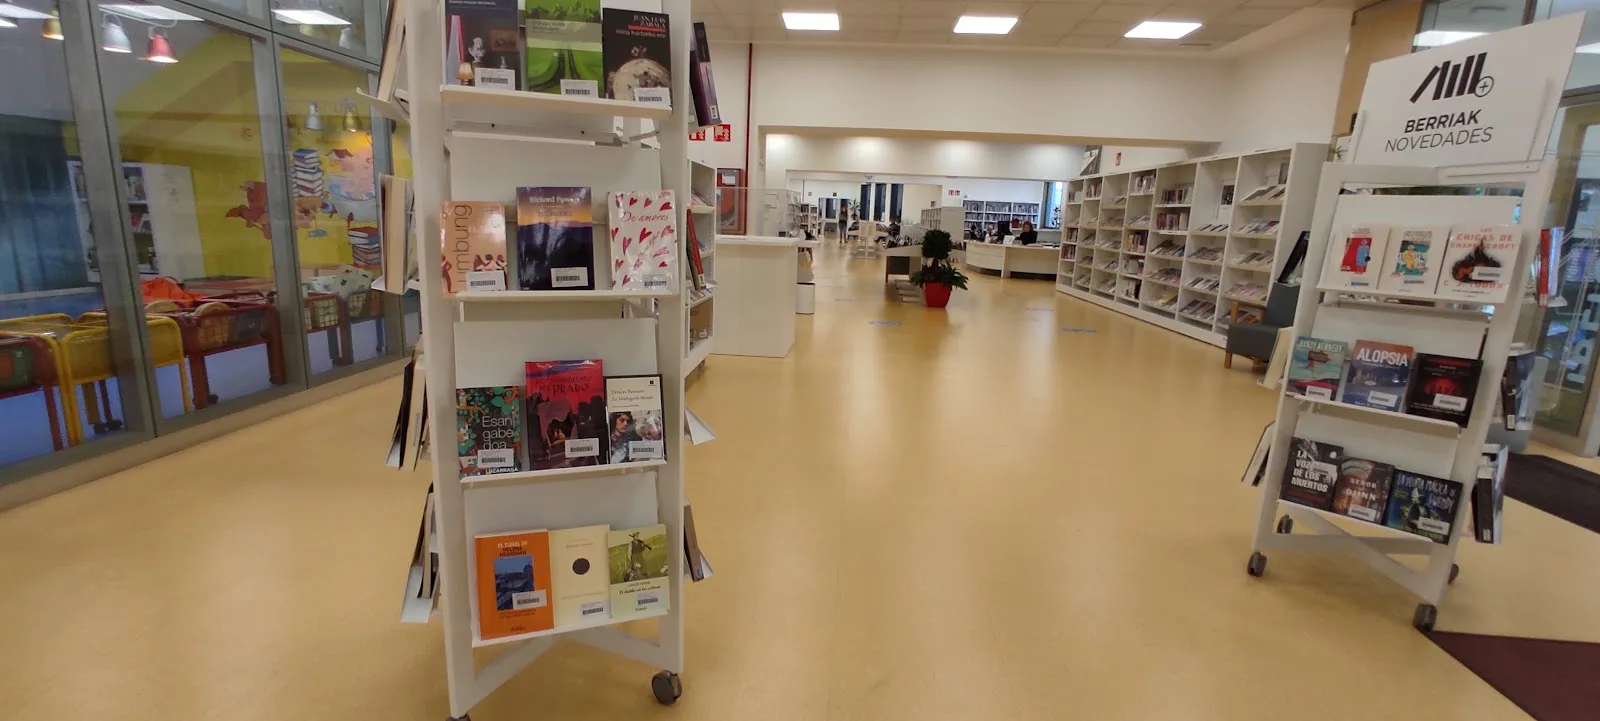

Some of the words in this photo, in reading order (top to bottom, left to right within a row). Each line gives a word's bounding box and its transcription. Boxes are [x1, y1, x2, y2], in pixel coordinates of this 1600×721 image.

[1404, 109, 1482, 133] BERRIAK
[1384, 126, 1494, 152] NOVEDADES
[529, 195, 555, 203] Richard
[621, 211, 637, 221] De
[641, 213, 669, 221] amores
[1456, 233, 1495, 241] CHICAS
[1357, 348, 1408, 367] ALOPSIA
[552, 383, 589, 396] PRADO
[482, 415, 513, 428] Esan
[482, 428, 514, 442] gabe
[483, 440, 507, 450] doa
[1297, 450, 1307, 459] LA
[1295, 459, 1311, 469] VOZ
[1293, 468, 1303, 477] DE
[1305, 471, 1320, 480] LOS
[1291, 477, 1329, 492] MUERTOS
